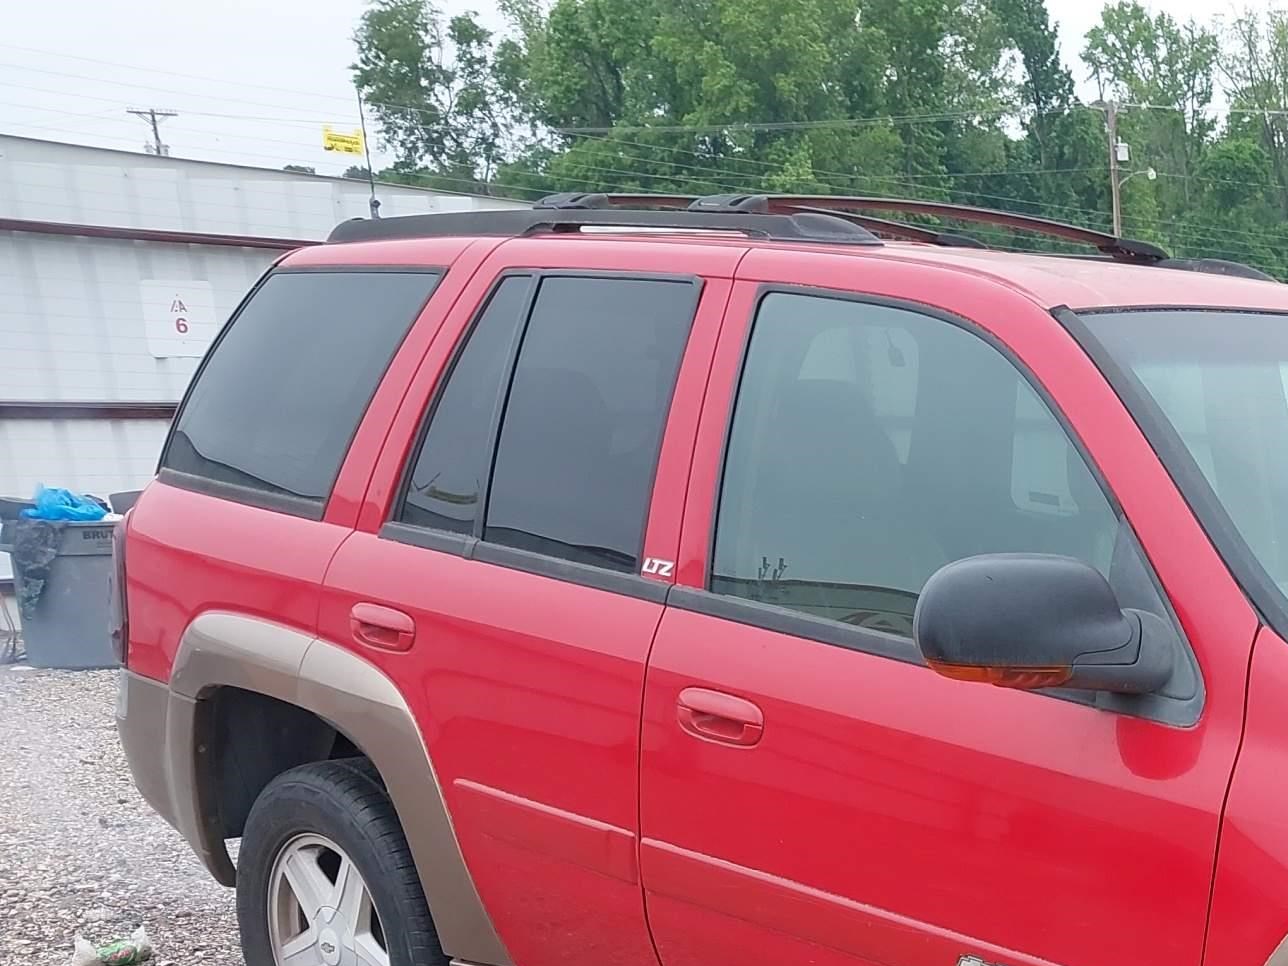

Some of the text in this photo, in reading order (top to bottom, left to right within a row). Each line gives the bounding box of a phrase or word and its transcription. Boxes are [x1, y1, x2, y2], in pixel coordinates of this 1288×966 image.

[175, 318, 189, 334] 6
[82, 530, 114, 540] BRUT
[642, 557, 675, 577] LTZ
